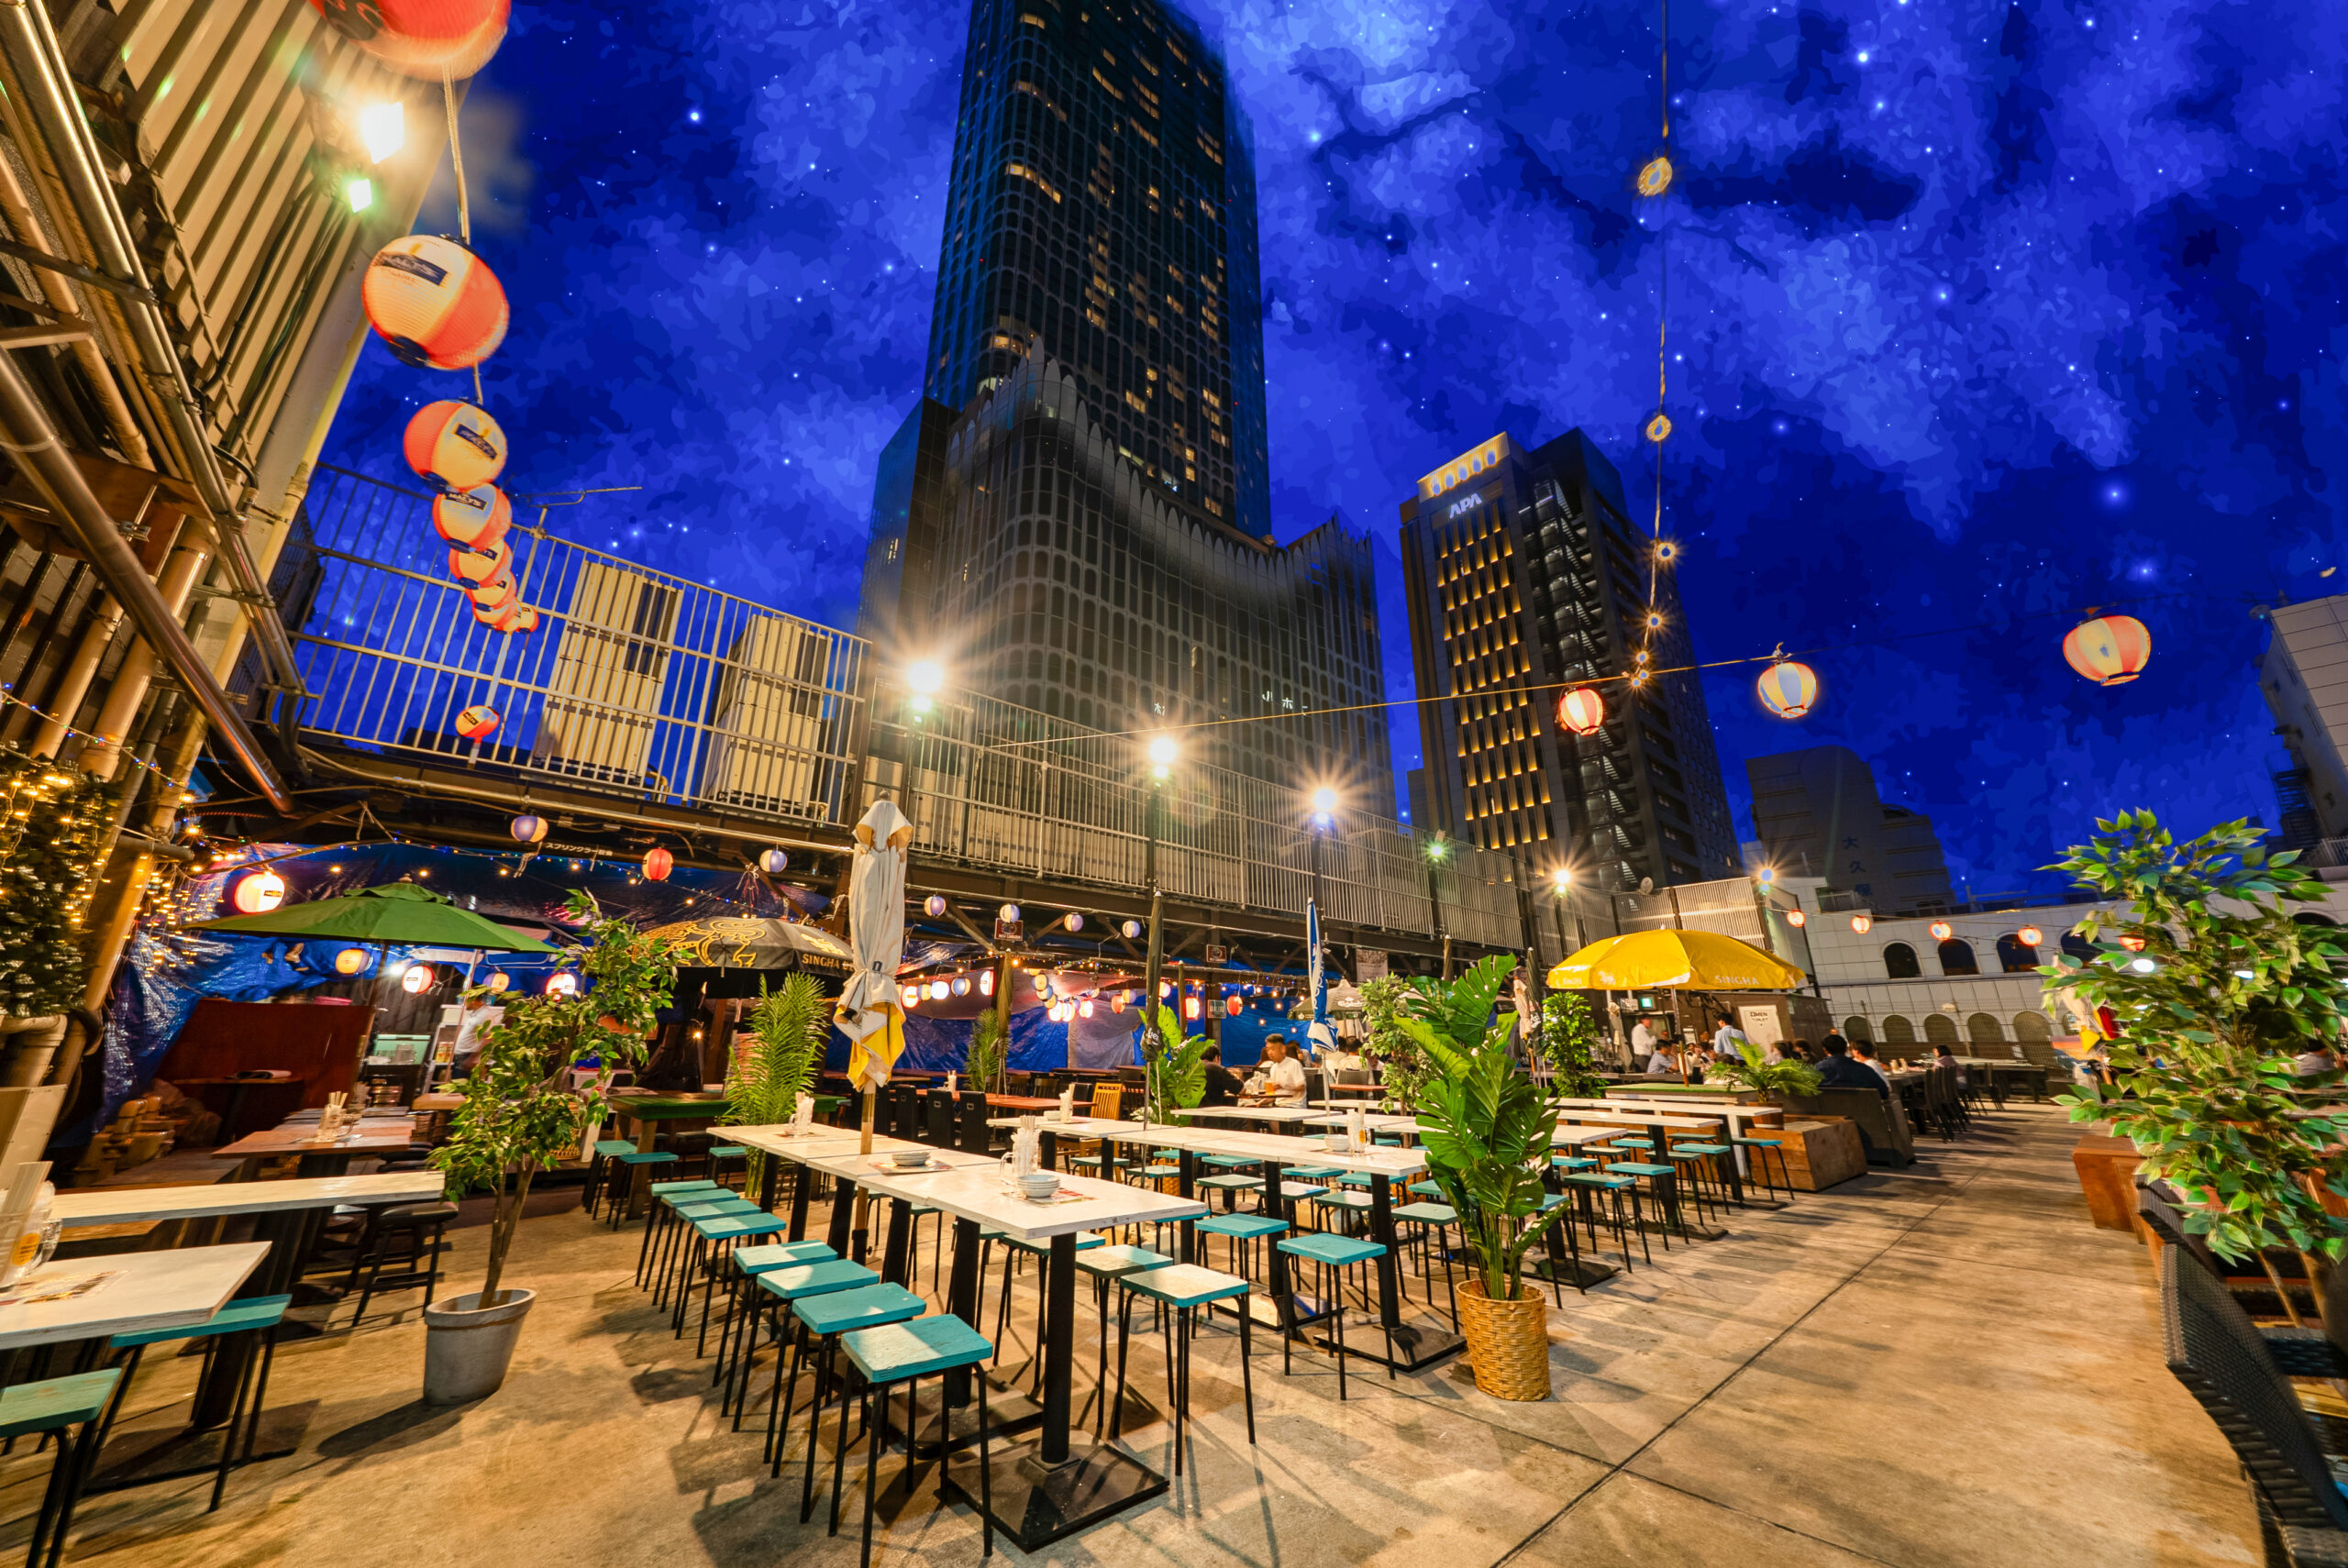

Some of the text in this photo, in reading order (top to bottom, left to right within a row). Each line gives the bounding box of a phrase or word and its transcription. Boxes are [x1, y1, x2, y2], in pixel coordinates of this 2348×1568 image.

[1449, 492, 1482, 519] APA
[802, 953, 840, 969] SINGHA
[1714, 975, 1760, 986] SINGHA
